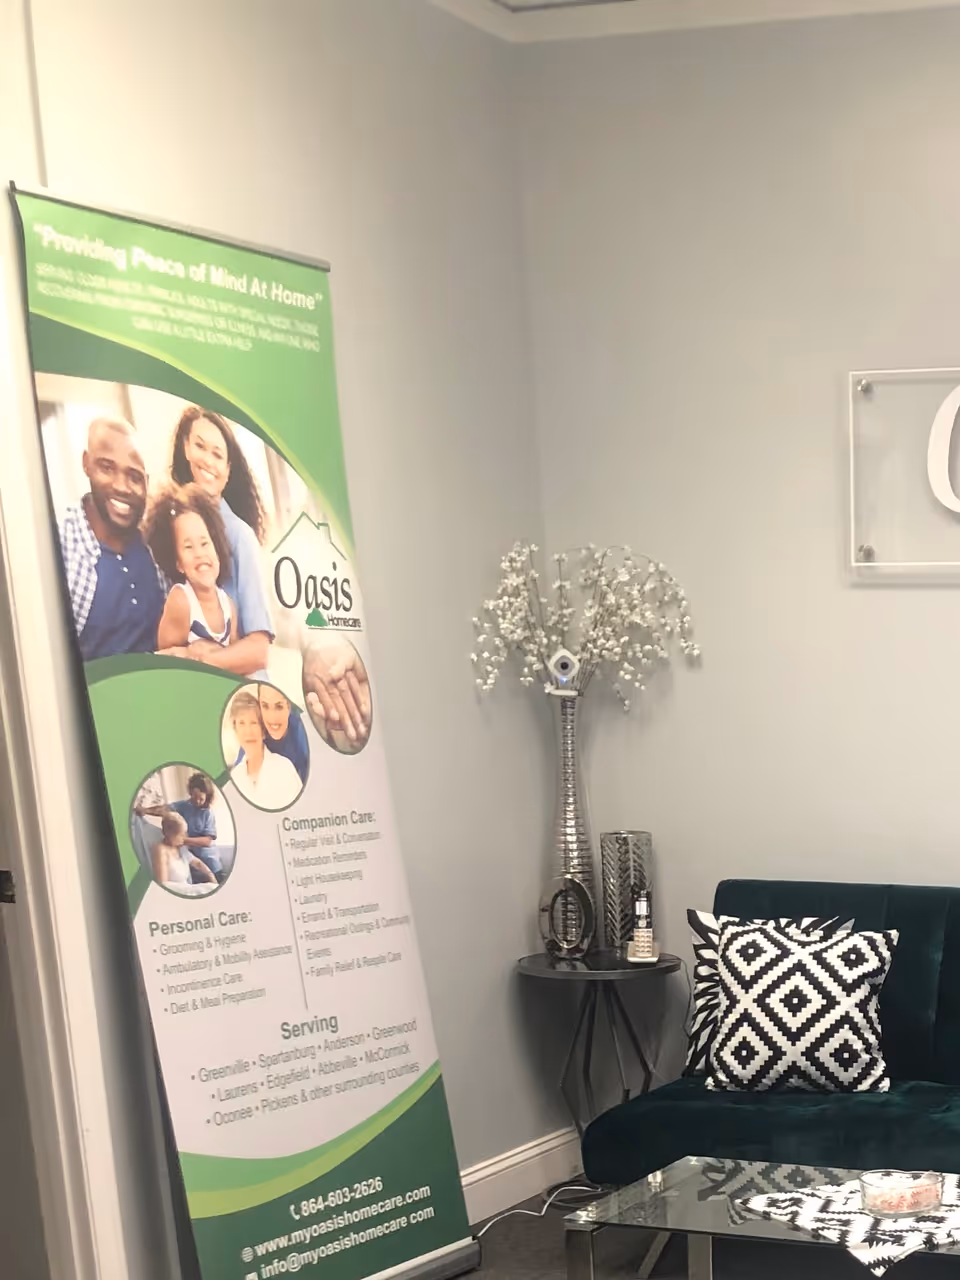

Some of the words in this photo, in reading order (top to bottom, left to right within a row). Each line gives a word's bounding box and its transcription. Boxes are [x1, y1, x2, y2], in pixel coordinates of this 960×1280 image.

[190, 263, 206, 283] of
[210, 265, 247, 294] Mind
[251, 277, 267, 298] At
[274, 556, 353, 612] Oasis
[327, 614, 361, 628] Homecare
[282, 813, 348, 832] Companion
[350, 811, 375, 824] Care:
[336, 833, 341, 844] &
[149, 913, 214, 937] Personal
[218, 911, 252, 927] Care:
[159, 940, 205, 956] Grooming
[206, 937, 213, 949] &
[214, 933, 246, 949] Hygiene
[163, 959, 213, 976] Ambulatory
[215, 956, 221, 967] &
[223, 972, 244, 985] Care
[170, 1002, 190, 1015] Diet
[192, 999, 199, 1011] &
[280, 1015, 339, 1040] Serving
[199, 1058, 250, 1083] Greenville
[258, 1044, 316, 1069] Spartanburg
[323, 1031, 366, 1052] Anderson
[372, 1018, 418, 1041] Greenwood
[216, 1080, 259, 1102] Laurens
[266, 1066, 311, 1090] Edgefield
[318, 1054, 358, 1076] Abbeville
[364, 1041, 411, 1064] McCormick
[213, 1106, 254, 1127] Oconee
[261, 1094, 299, 1113] Pickens
[301, 1088, 309, 1103] &
[310, 1083, 333, 1101] other
[335, 1069, 386, 1094] surrounding
[387, 1061, 420, 1081] counties
[300, 1176, 383, 1217] 864-603-2626
[254, 1185, 431, 1257] www.myoasishomecare.com
[260, 1206, 435, 1279] info@myoasishomecarecom
